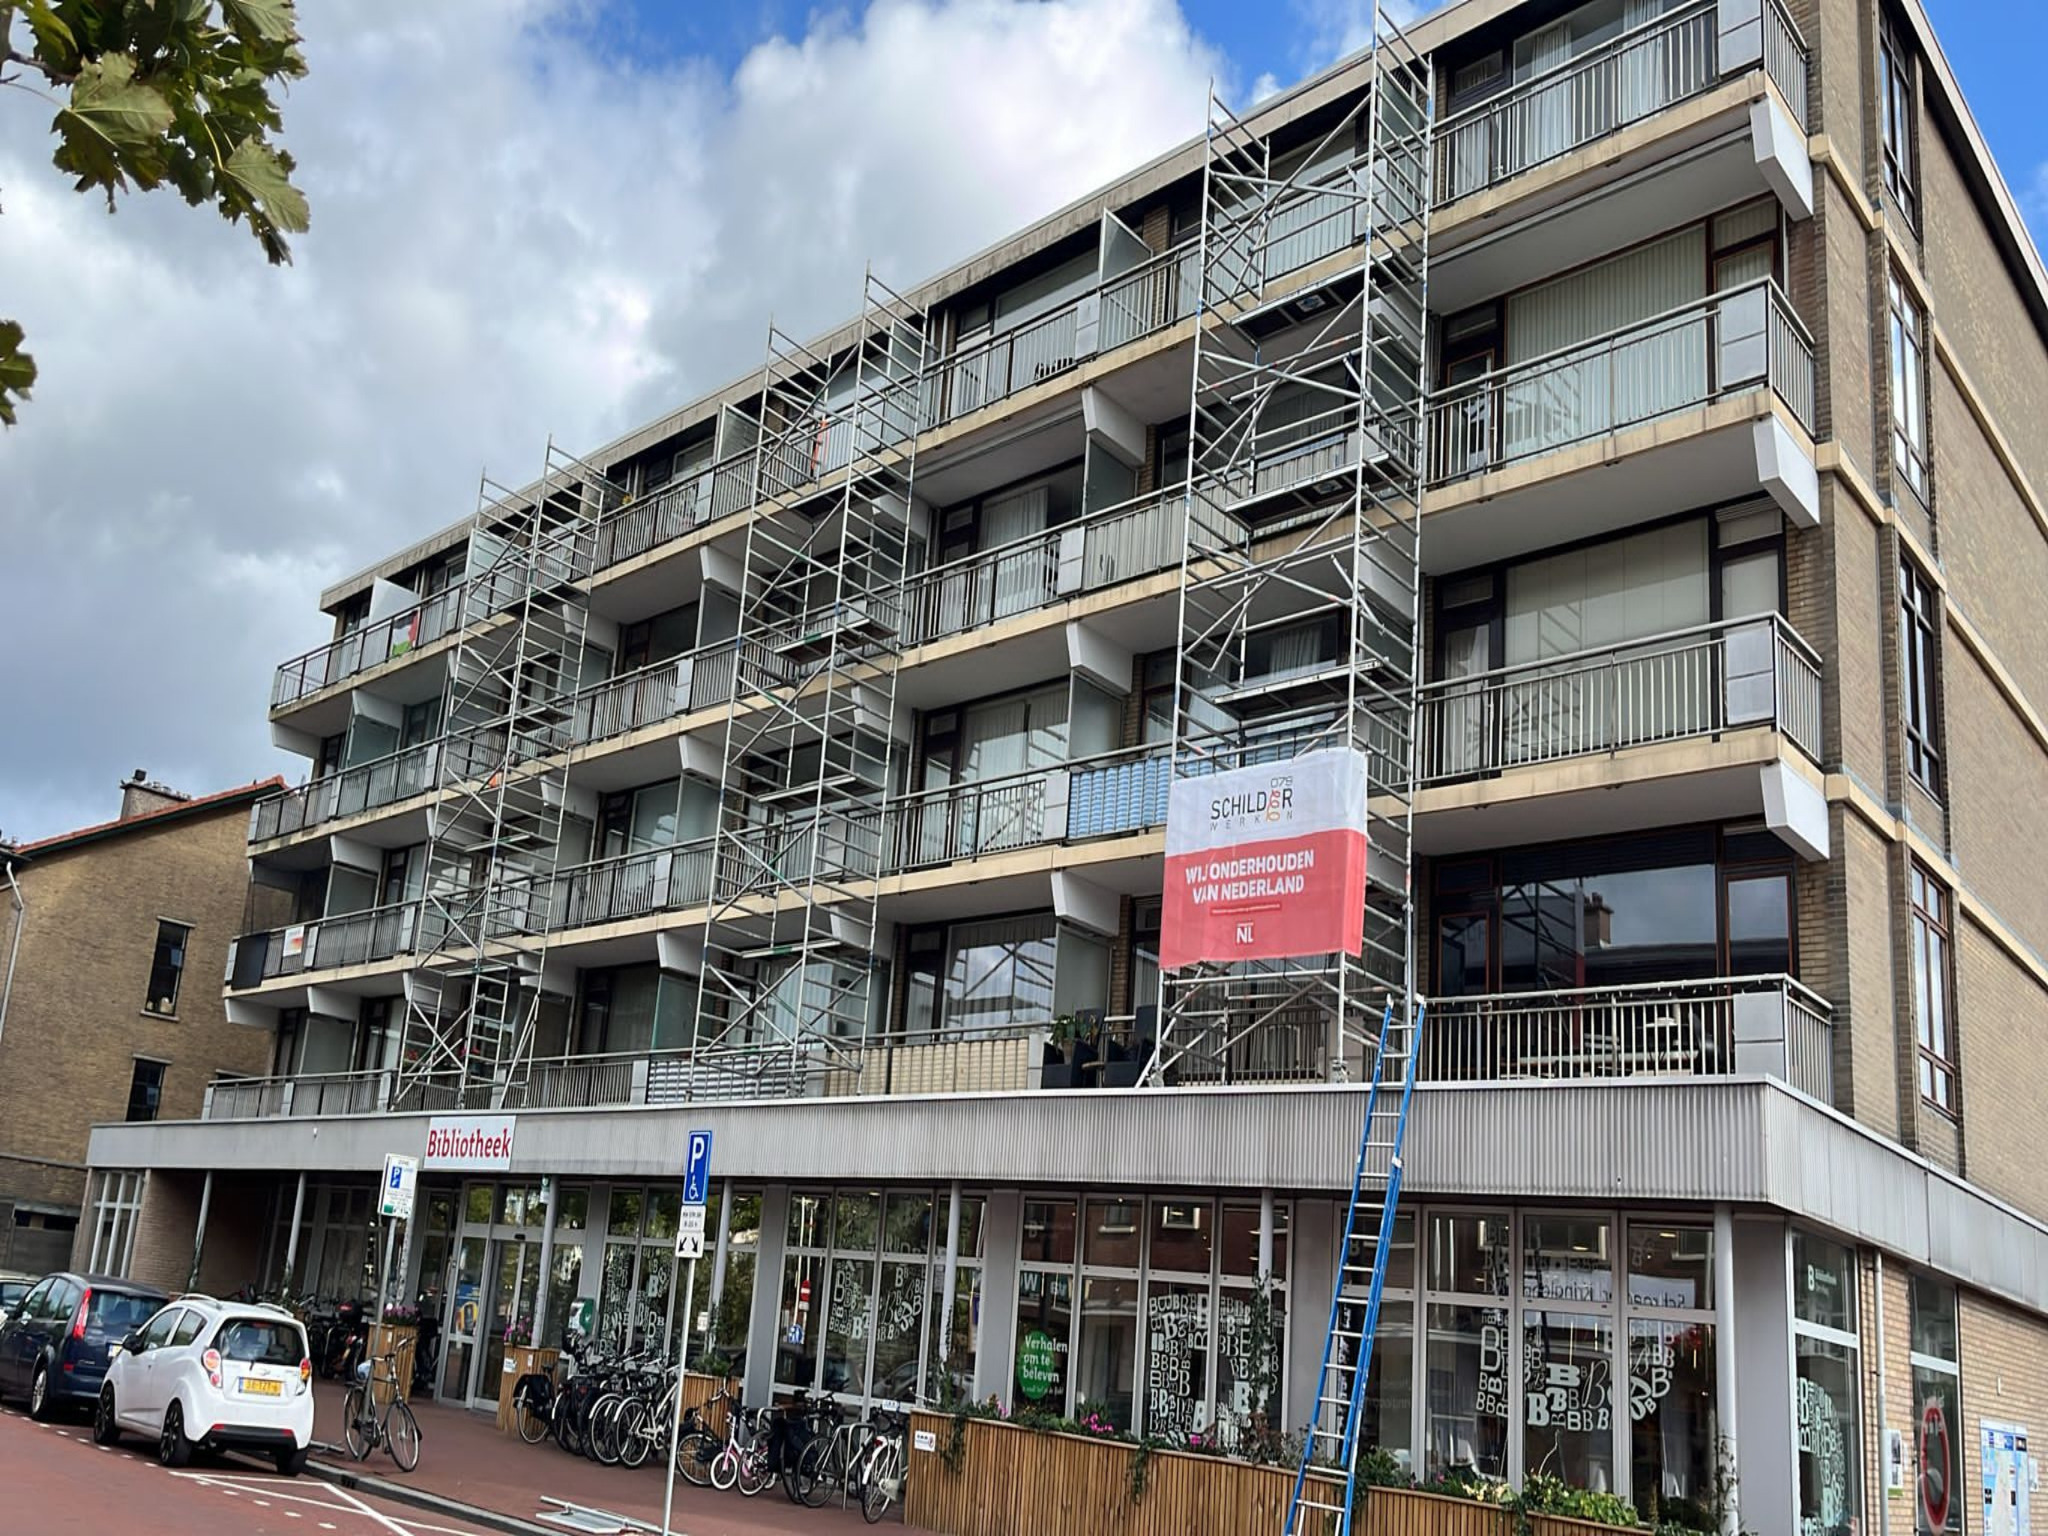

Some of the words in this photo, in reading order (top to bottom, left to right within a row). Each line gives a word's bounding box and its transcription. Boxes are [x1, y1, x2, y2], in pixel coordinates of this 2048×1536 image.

[1185, 864, 1208, 885] WIJ
[1209, 849, 1314, 879] ONDERHOUDEN
[1193, 884, 1219, 904] VAN
[1221, 874, 1304, 901] NEDERLAND
[1236, 926, 1254, 943] NL
[427, 1128, 511, 1158] Bibliotheek
[690, 1137, 705, 1173] P
[852, 1316, 862, 1339] B
[1162, 1312, 1178, 1340] B
[1025, 1335, 1068, 1353] Verhalen
[1481, 1326, 1501, 1371] B
[1024, 1354, 1038, 1364] om
[1041, 1353, 1050, 1365] te
[1023, 1365, 1059, 1382] beleven
[1179, 1370, 1190, 1396] B
[1546, 1363, 1580, 1387] B
[1652, 1367, 1670, 1398] B
[1476, 1392, 1485, 1410] B
[1486, 1395, 1495, 1413] B
[1527, 1393, 1549, 1426] B
[1546, 1387, 1567, 1411] B
[1569, 1388, 1579, 1409] B
[1568, 1411, 1581, 1430] B
[1583, 1409, 1593, 1431] B
[1597, 1408, 1609, 1429] B
